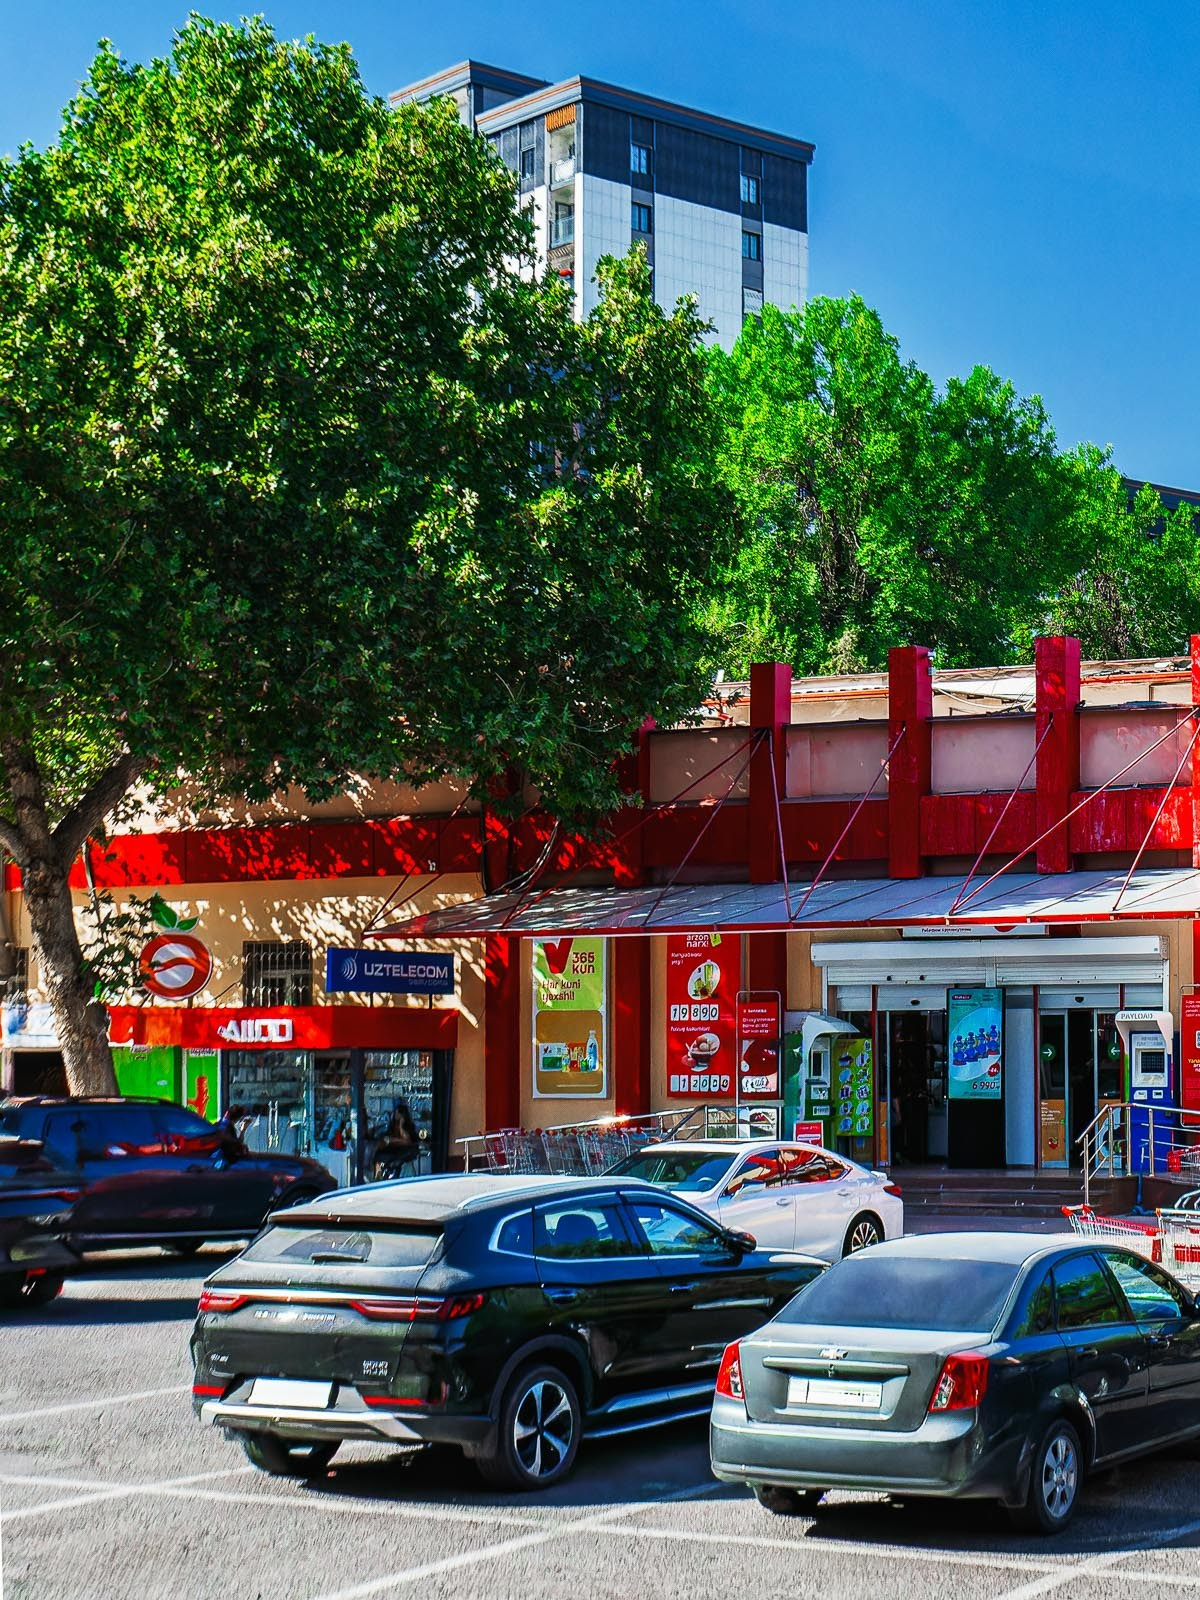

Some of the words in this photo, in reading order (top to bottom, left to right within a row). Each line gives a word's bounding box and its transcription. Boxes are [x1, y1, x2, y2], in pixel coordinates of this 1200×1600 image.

[572, 951, 595, 963] 365
[364, 962, 449, 979] UZTELECOM
[572, 964, 595, 974] kun
[560, 978, 581, 989] kuni
